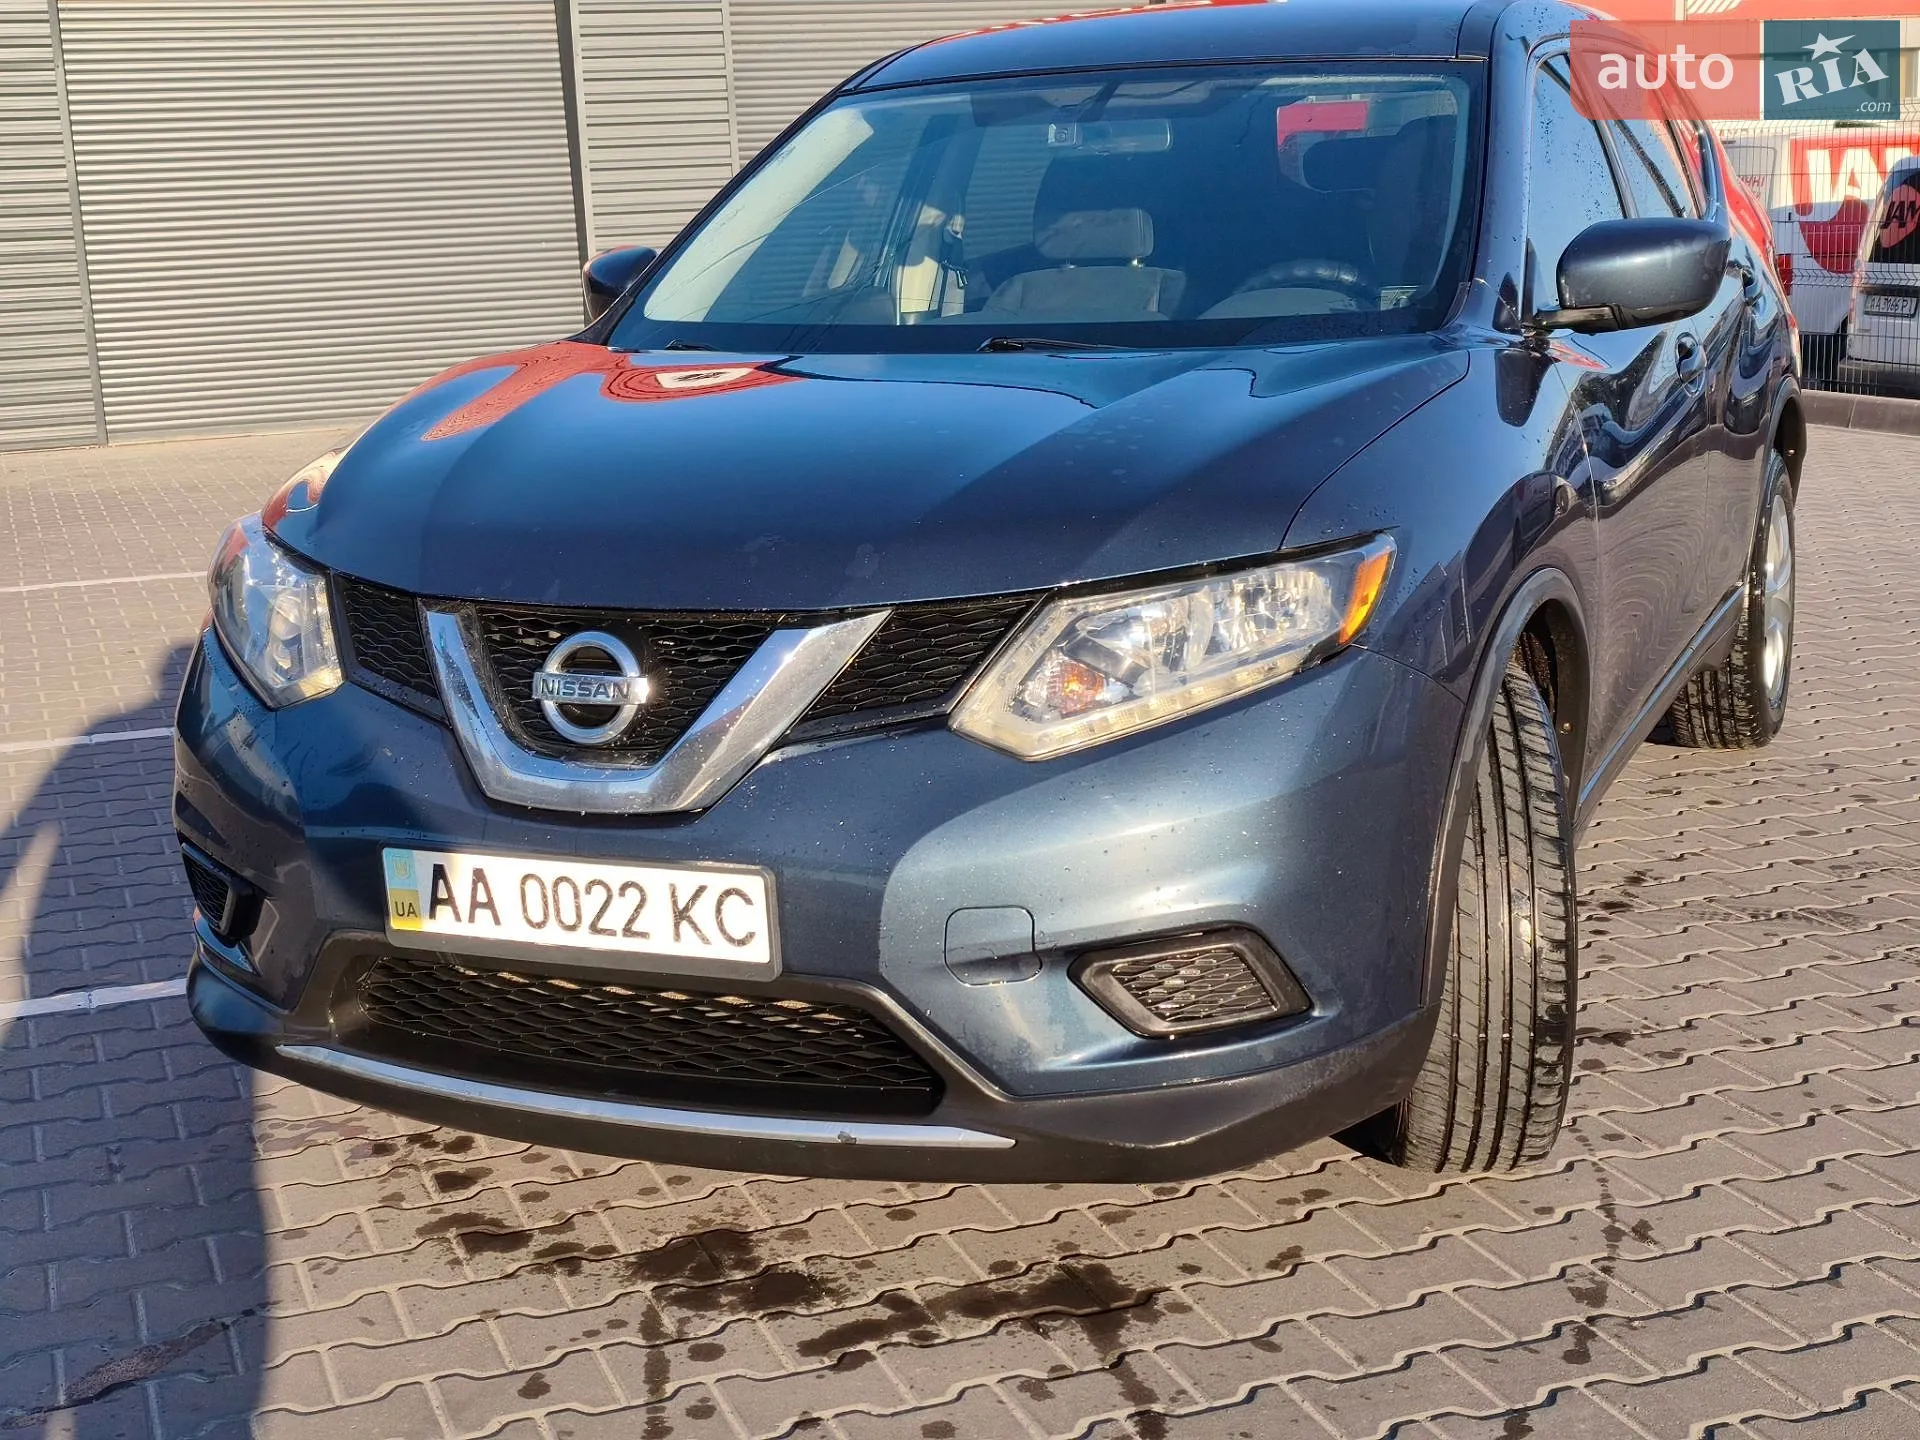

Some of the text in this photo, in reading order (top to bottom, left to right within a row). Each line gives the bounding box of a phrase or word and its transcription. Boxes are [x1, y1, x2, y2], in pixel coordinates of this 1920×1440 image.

[541, 679, 630, 699] NISSAN
[395, 901, 418, 918] UA
[429, 864, 756, 948] AA 0022 KC
